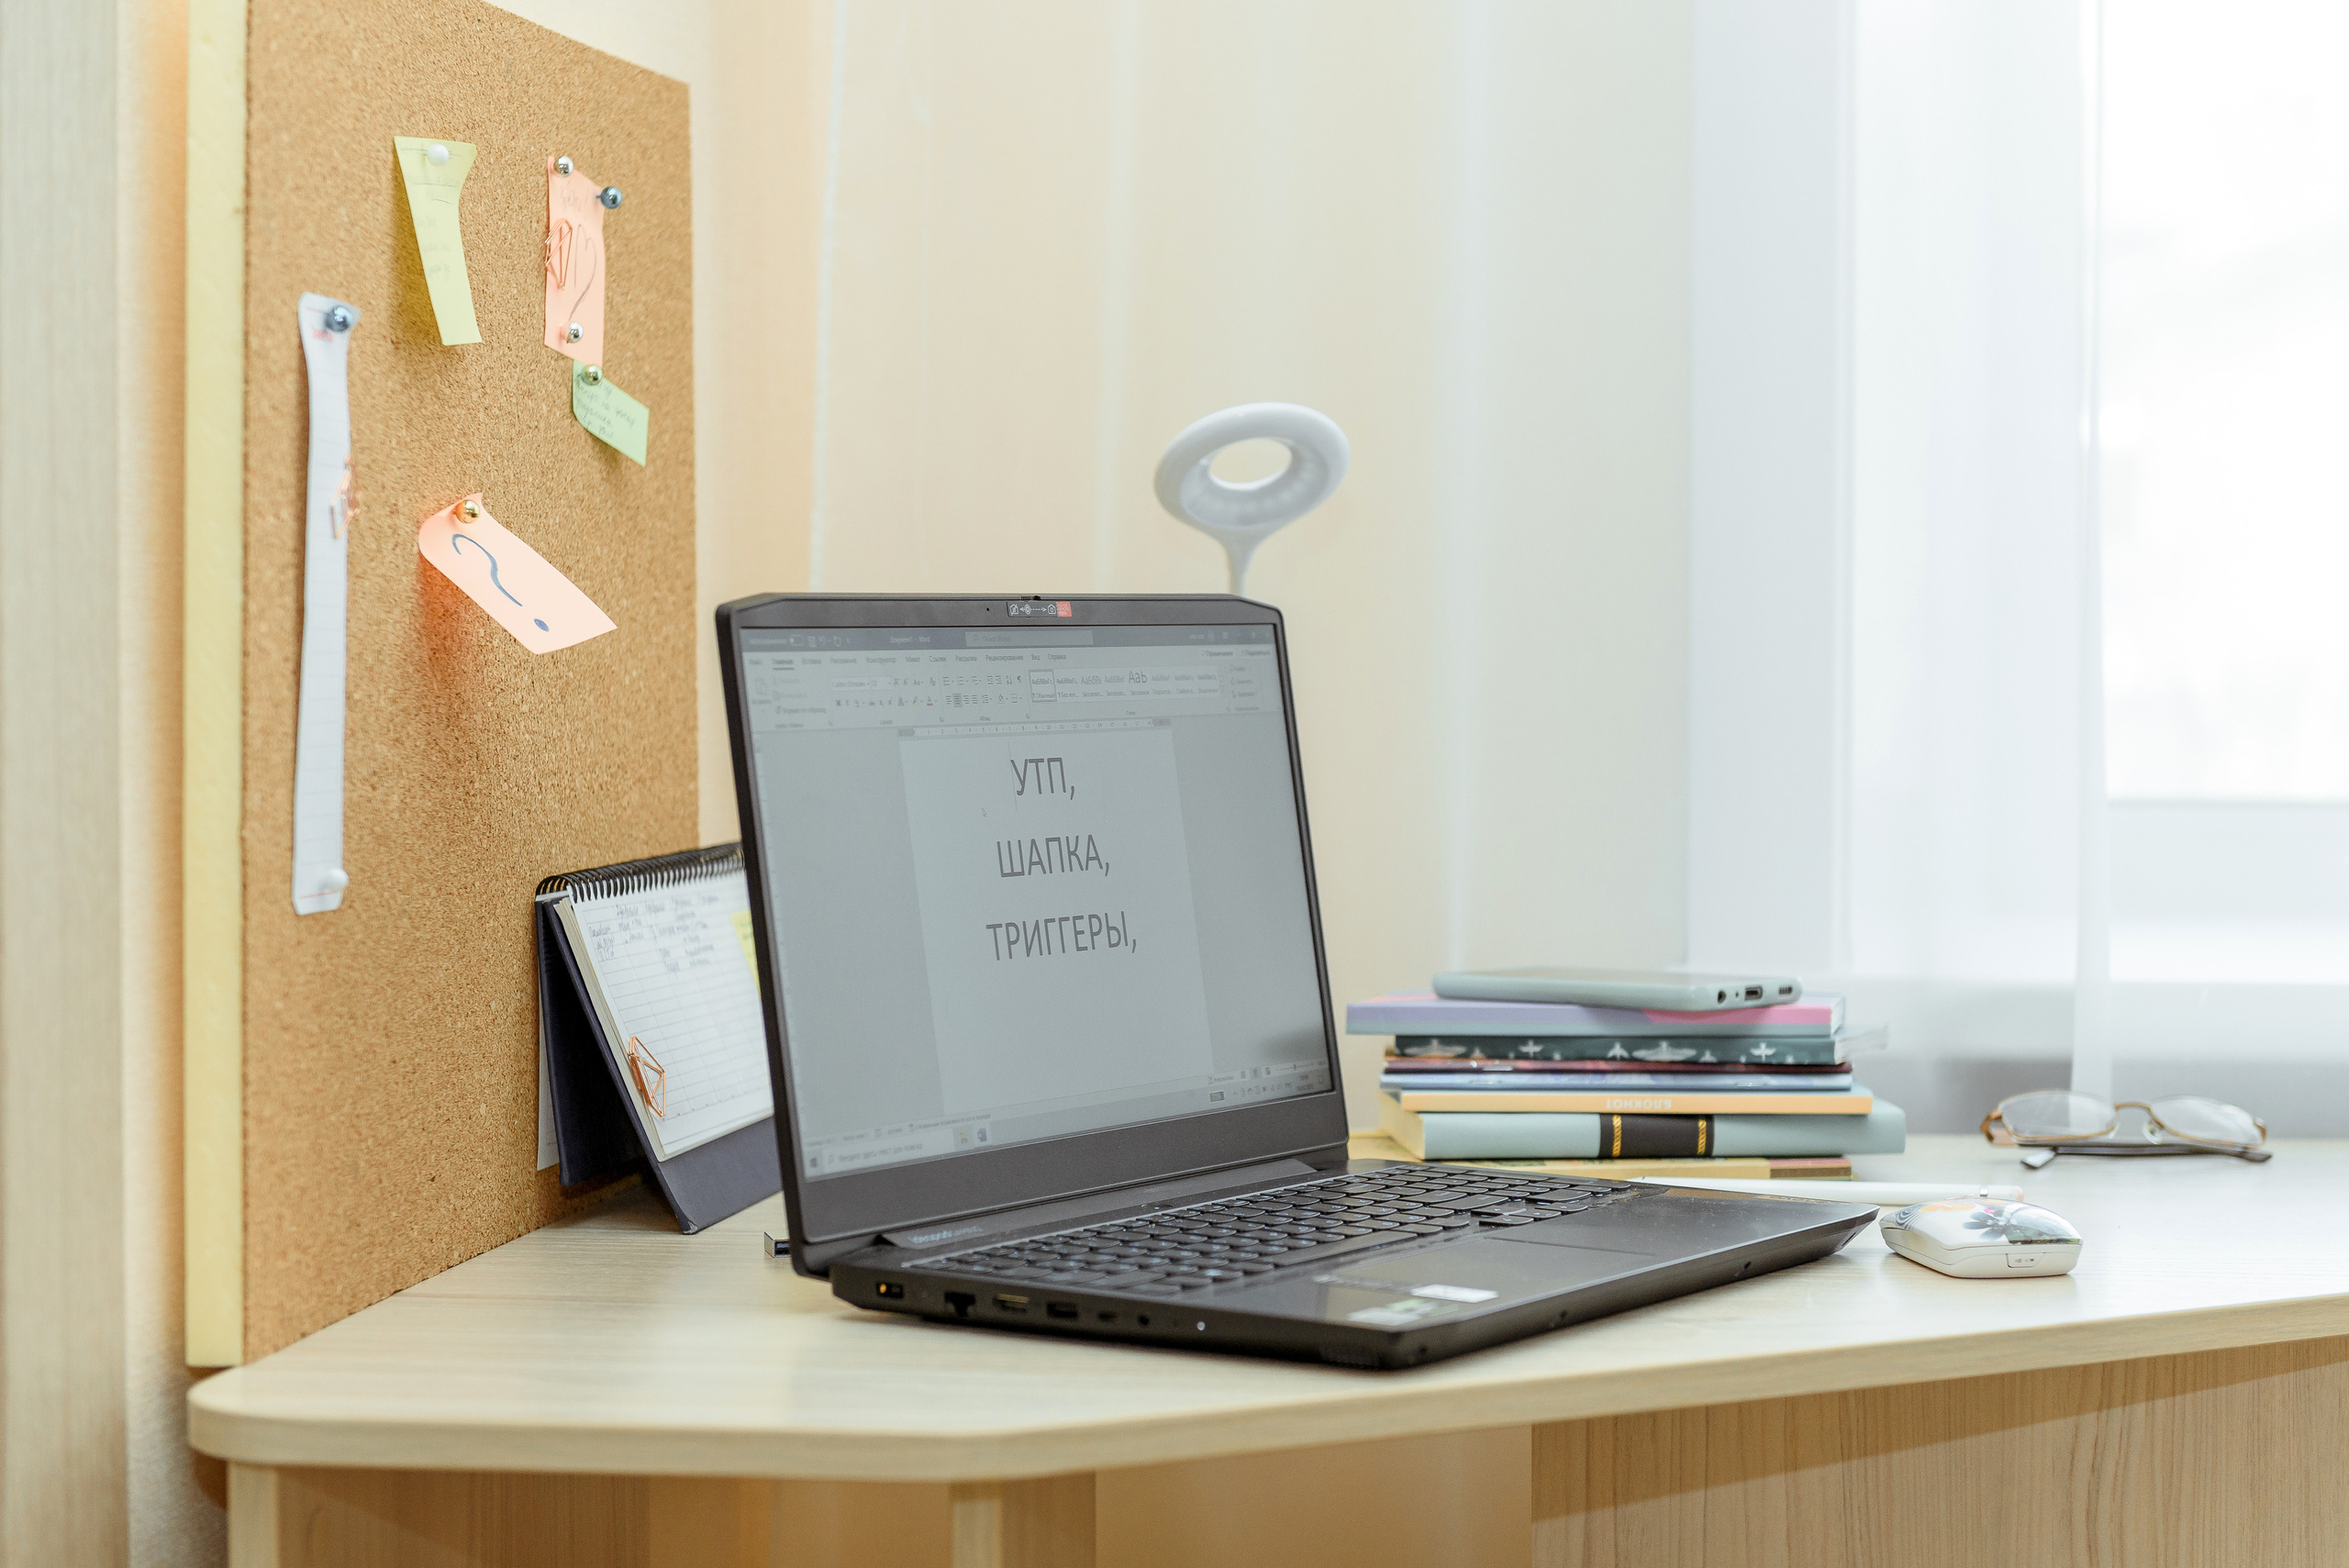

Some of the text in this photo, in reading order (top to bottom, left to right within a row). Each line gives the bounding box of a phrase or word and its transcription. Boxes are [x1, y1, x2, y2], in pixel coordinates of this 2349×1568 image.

[1031, 653, 1041, 662] Вид
[1047, 652, 1066, 662] Справка
[1010, 757, 1075, 800] УТП,
[996, 834, 1109, 877] ШАПКА,
[985, 910, 1137, 961] ТРИГГЕРЫ,
[1606, 1098, 1672, 1110] БЛОКНОТ
